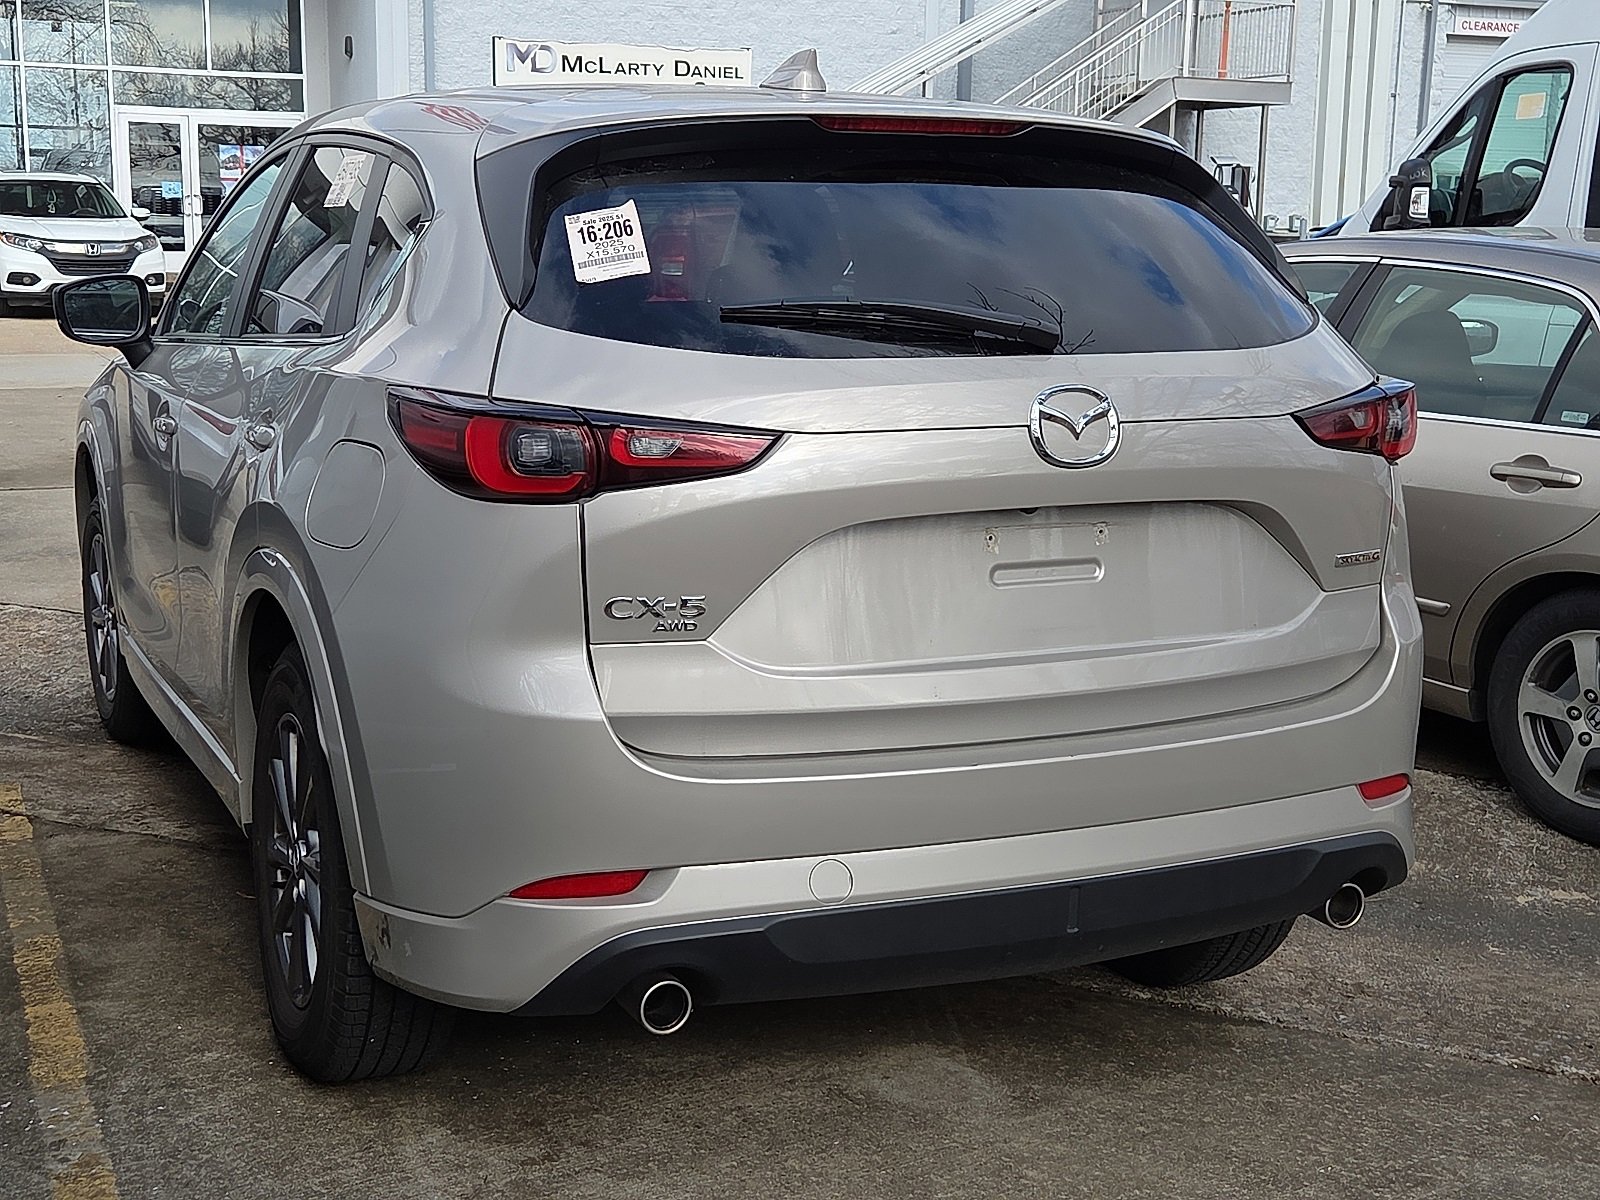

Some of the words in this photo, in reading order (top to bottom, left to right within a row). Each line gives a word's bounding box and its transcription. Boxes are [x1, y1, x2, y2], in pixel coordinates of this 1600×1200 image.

[1461, 20, 1520, 33] CLEARANCE
[506, 42, 558, 74] MD
[674, 60, 744, 79] DANIEL
[577, 218, 634, 245] 16:206
[594, 238, 624, 250] 2025
[604, 595, 706, 620] CX-5
[652, 619, 698, 632] AWD
